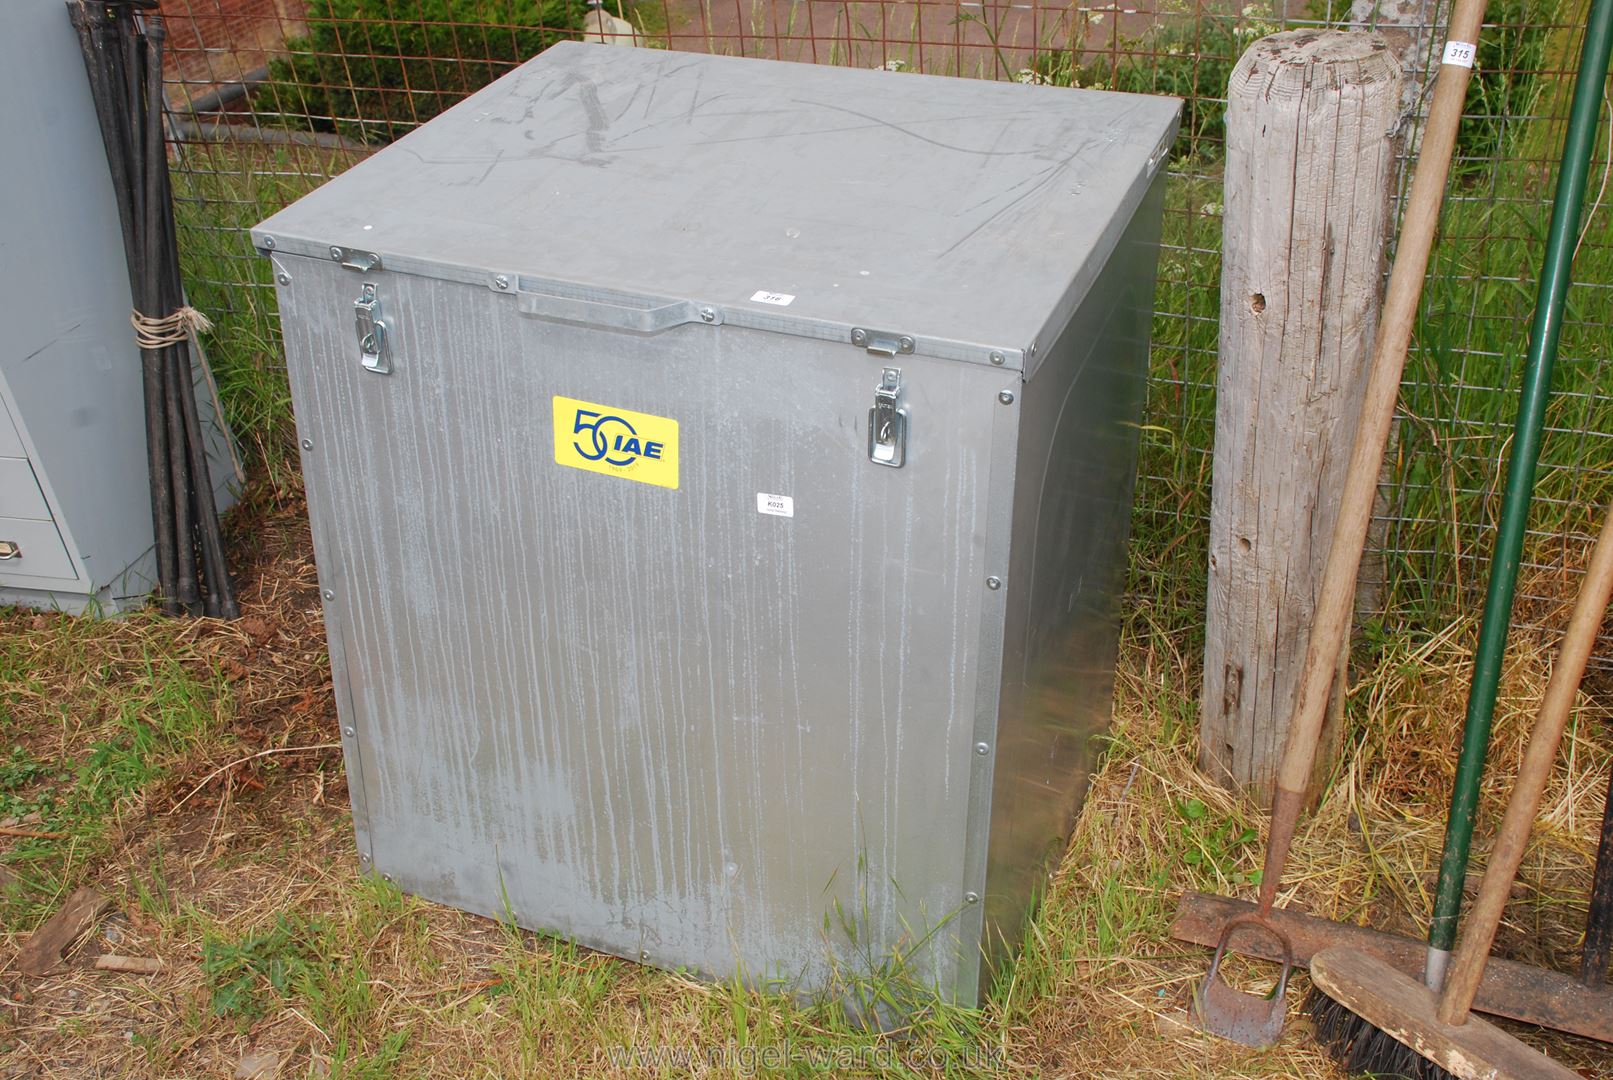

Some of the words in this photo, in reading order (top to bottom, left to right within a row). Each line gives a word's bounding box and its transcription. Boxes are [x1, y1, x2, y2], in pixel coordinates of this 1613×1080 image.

[1450, 48, 1470, 59] 315
[573, 409, 638, 467] 50
[613, 434, 664, 460] IAE
[767, 501, 784, 509] K025
